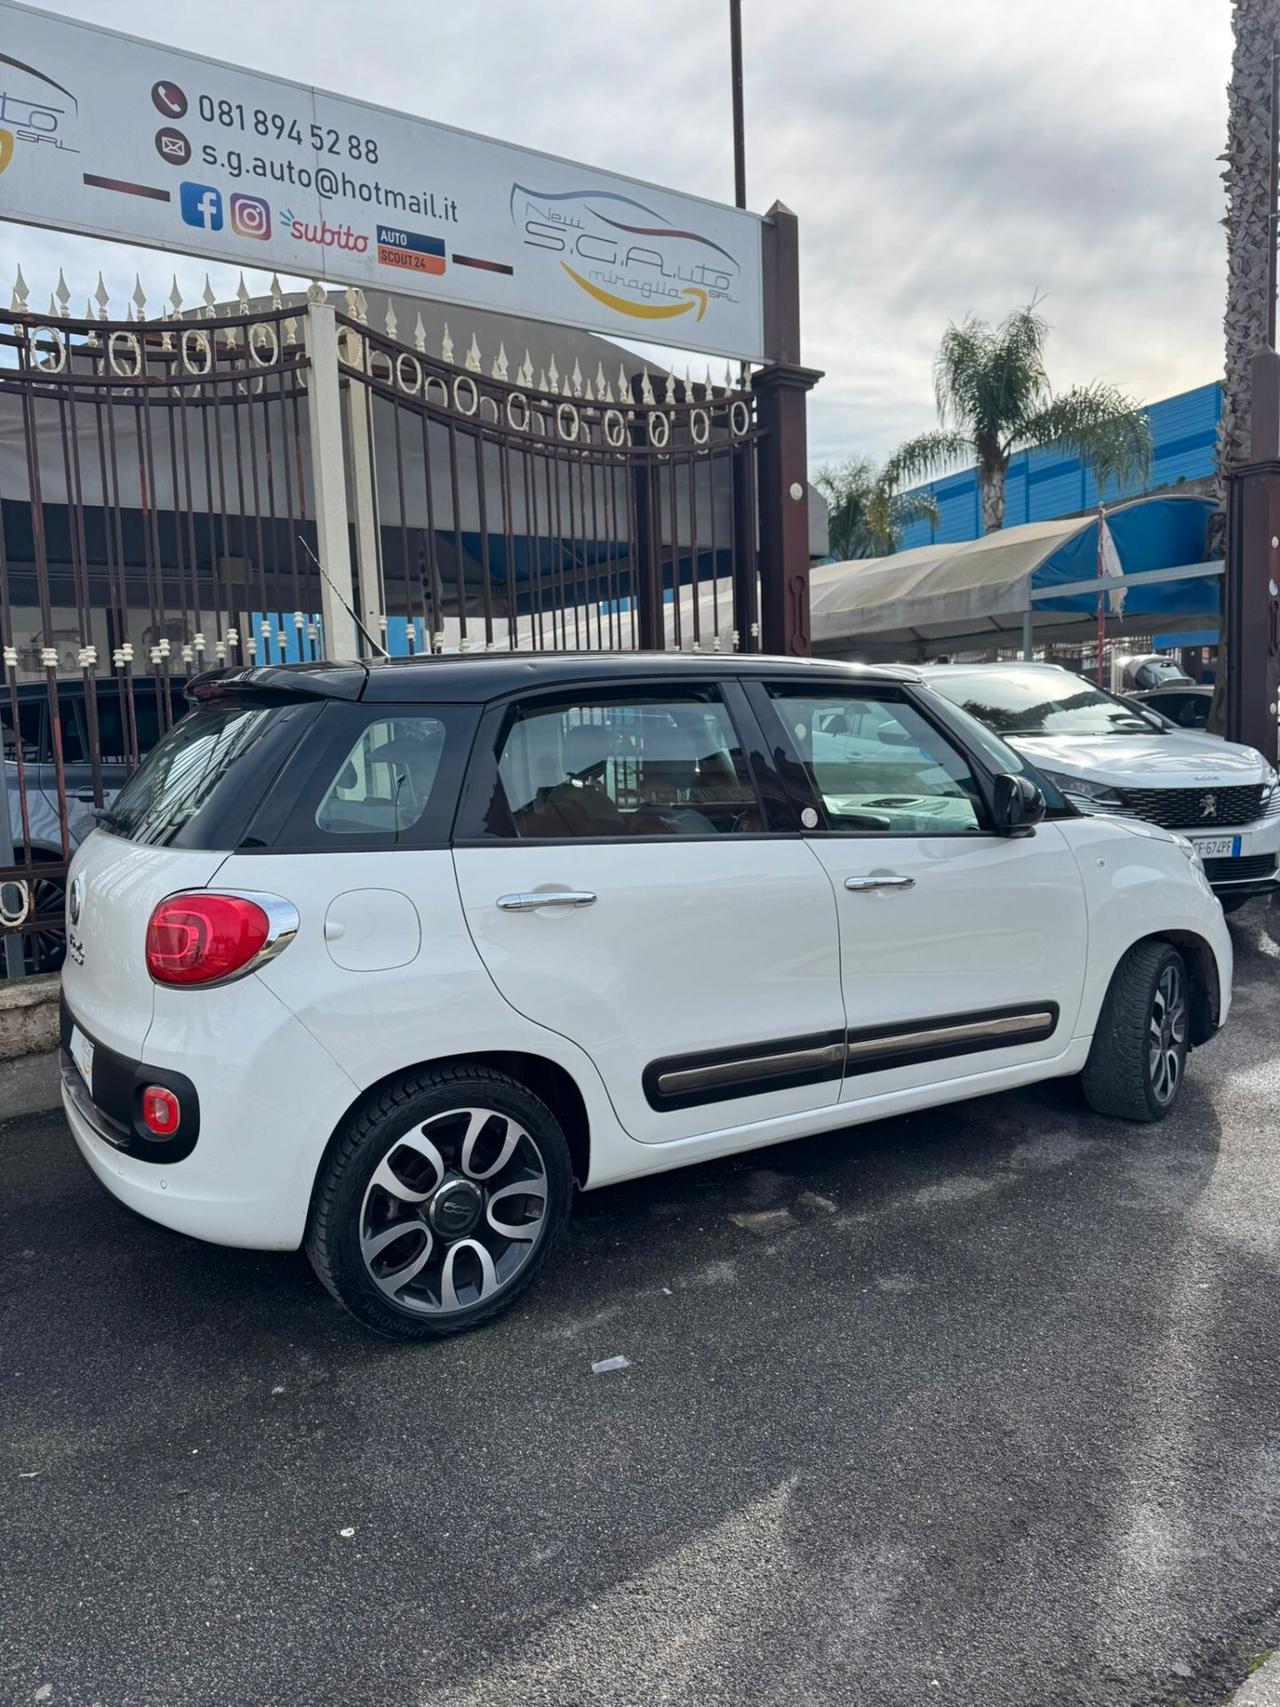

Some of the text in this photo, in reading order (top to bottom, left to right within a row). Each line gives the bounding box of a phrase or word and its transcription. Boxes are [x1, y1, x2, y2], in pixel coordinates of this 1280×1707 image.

[16, 129, 80, 153] SRL
[199, 95, 379, 165] 081 894 52 88
[202, 145, 459, 224] s.g.auto@hotmail.it
[526, 202, 585, 230] New
[290, 220, 369, 253] subito
[380, 230, 408, 246] AUTO
[588, 270, 683, 299] miraglia
[708, 289, 740, 304] SRL
[442, 1201, 473, 1216] 500
